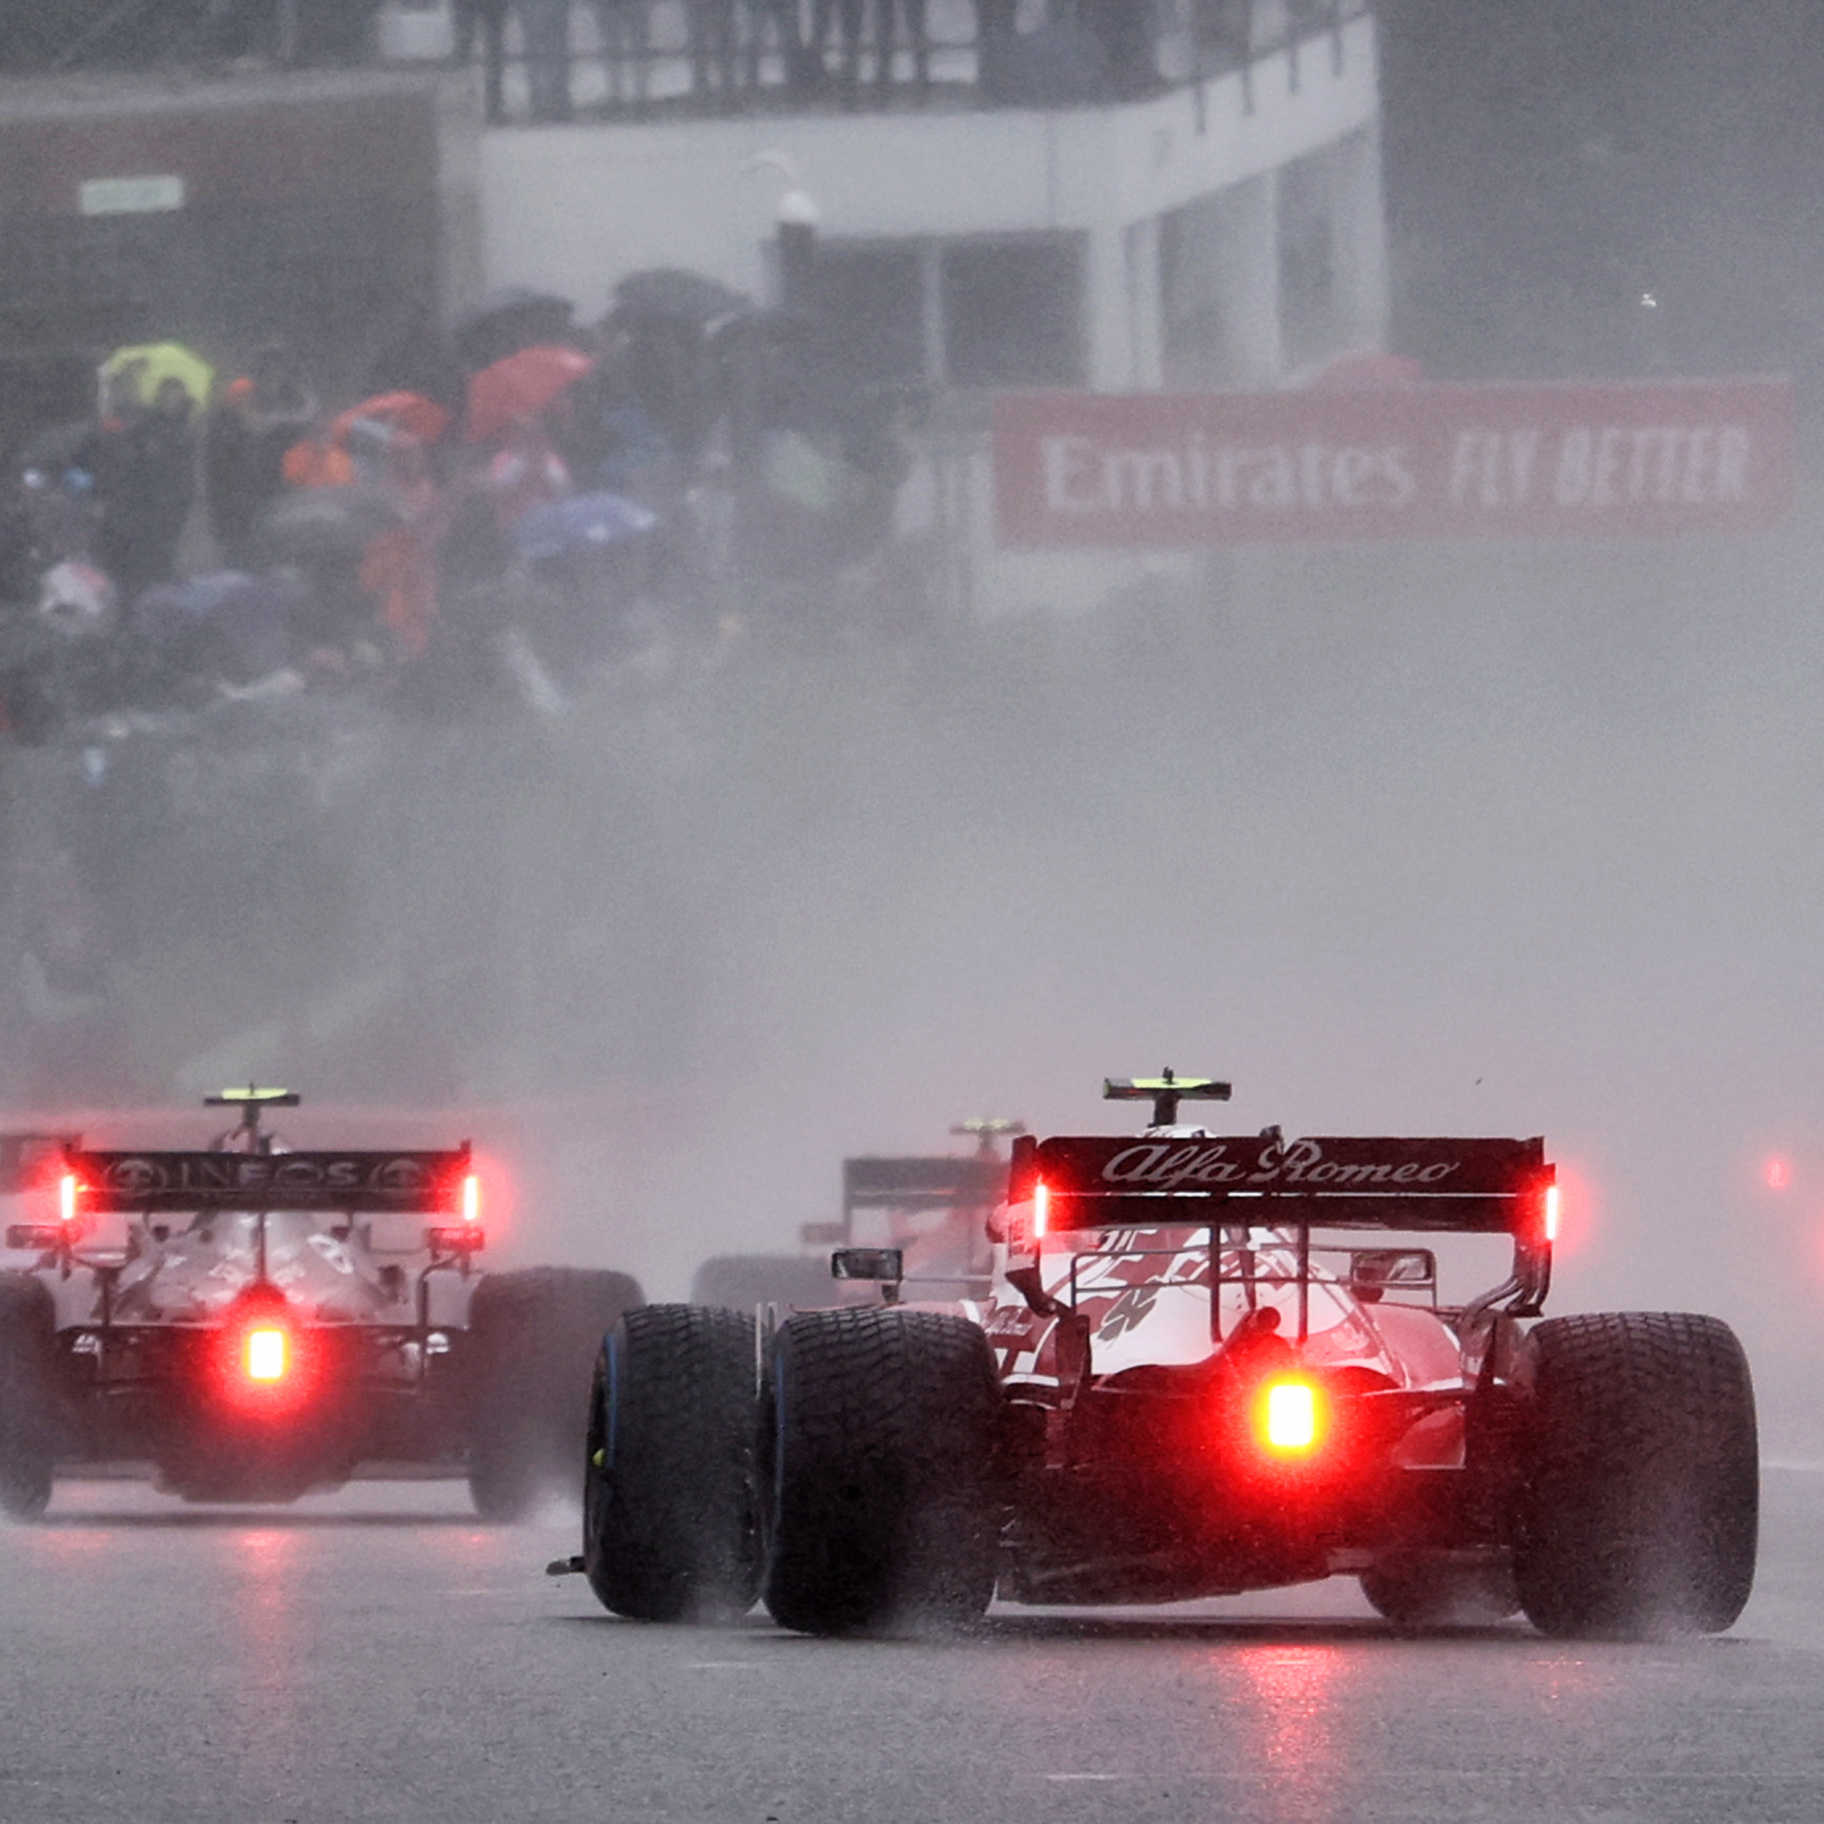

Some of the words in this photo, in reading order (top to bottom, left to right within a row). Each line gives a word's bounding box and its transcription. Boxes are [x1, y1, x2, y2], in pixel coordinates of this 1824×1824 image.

[1041, 433, 1417, 513] Emirates
[1450, 428, 1539, 507] FLY
[1554, 424, 1750, 504] BETTER
[180, 1160, 360, 1187] INEOS
[1101, 1143, 1246, 1186] Alfa
[1246, 1140, 1461, 1185] Romeo
